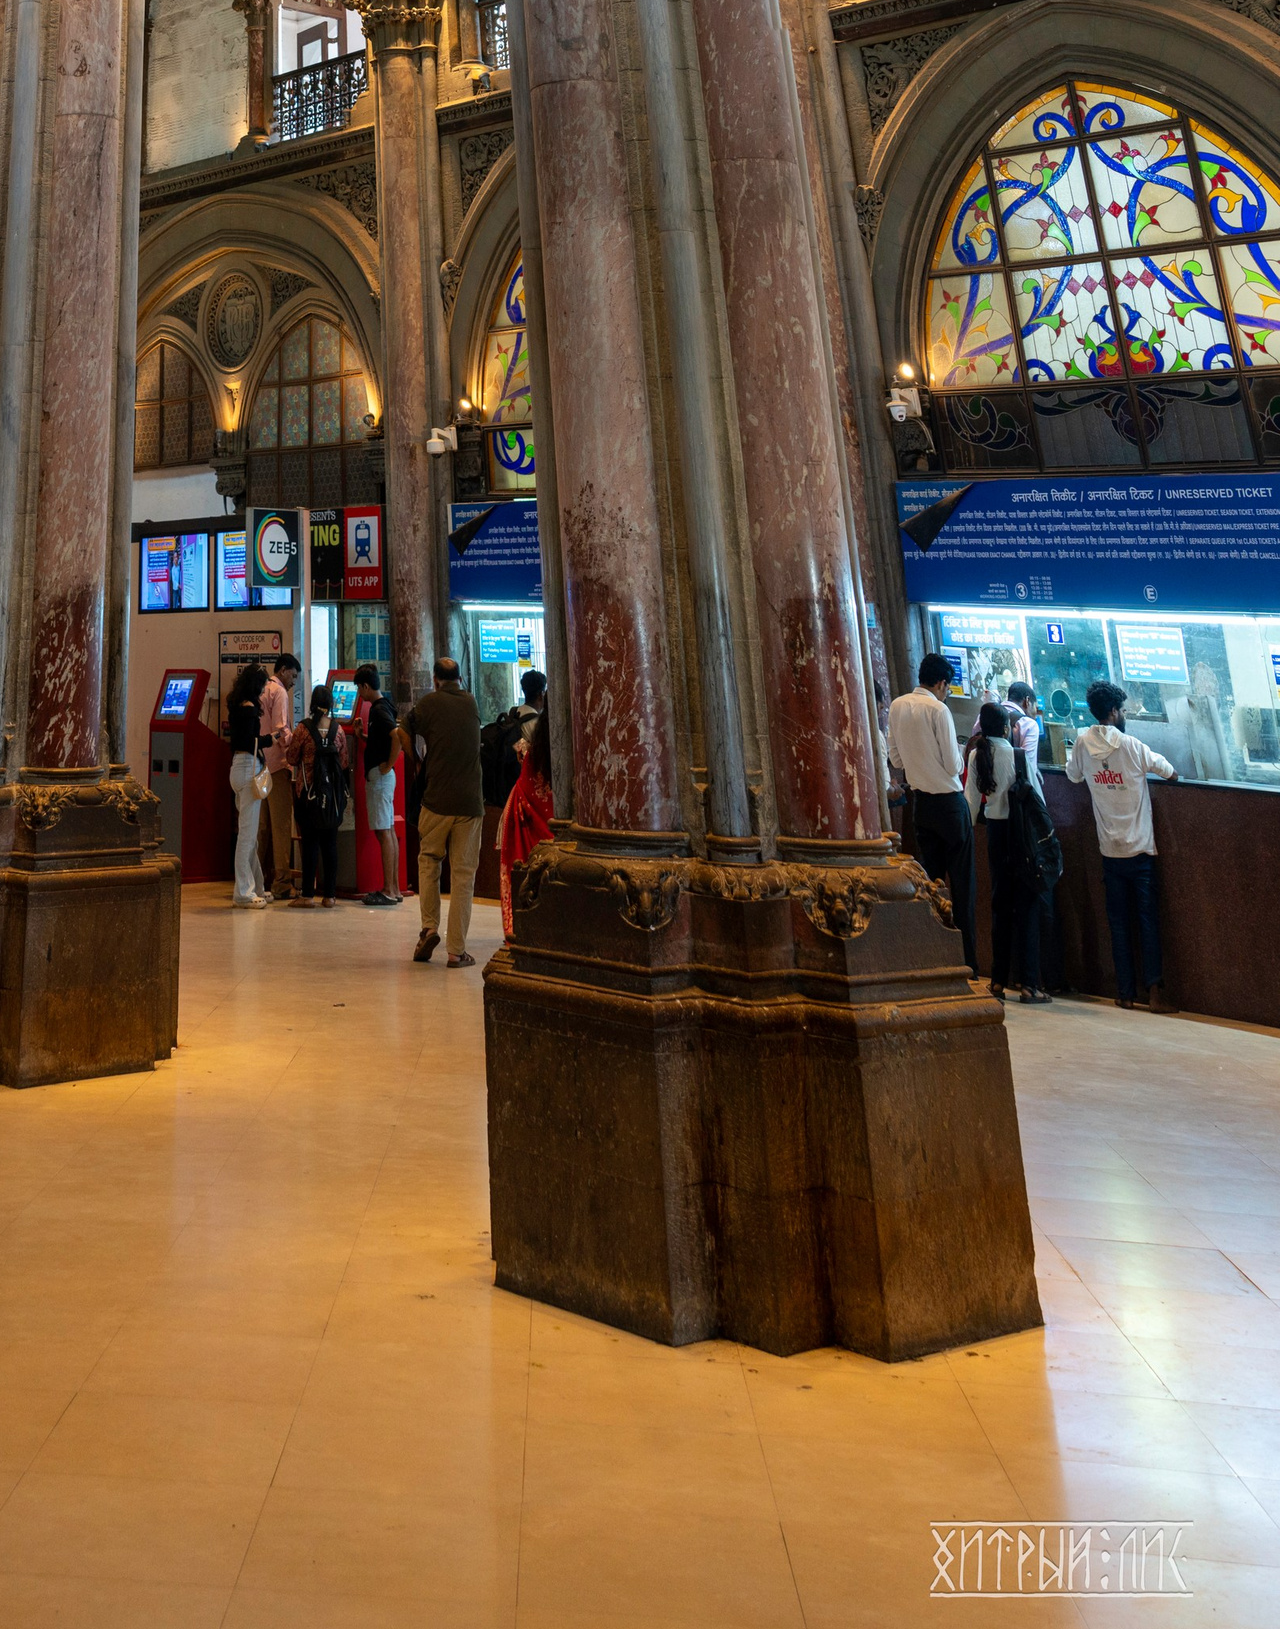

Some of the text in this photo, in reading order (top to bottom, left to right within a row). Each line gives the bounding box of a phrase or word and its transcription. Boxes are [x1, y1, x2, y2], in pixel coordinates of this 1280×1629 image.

[1011, 489, 1048, 503] अनारक्षित
[1050, 488, 1077, 502] तिकीट
[1087, 487, 1127, 501] अनारक्षित
[1129, 486, 1154, 500] टिकट
[1165, 488, 1234, 499] UNRESERVED
[1235, 487, 1273, 498] TICKET
[269, 541, 297, 555] ZEE5
[348, 576, 379, 587] UTS APP
[233, 635, 240, 644] QR
[240, 635, 255, 643] CODE
[1050, 625, 1060, 642] 3
